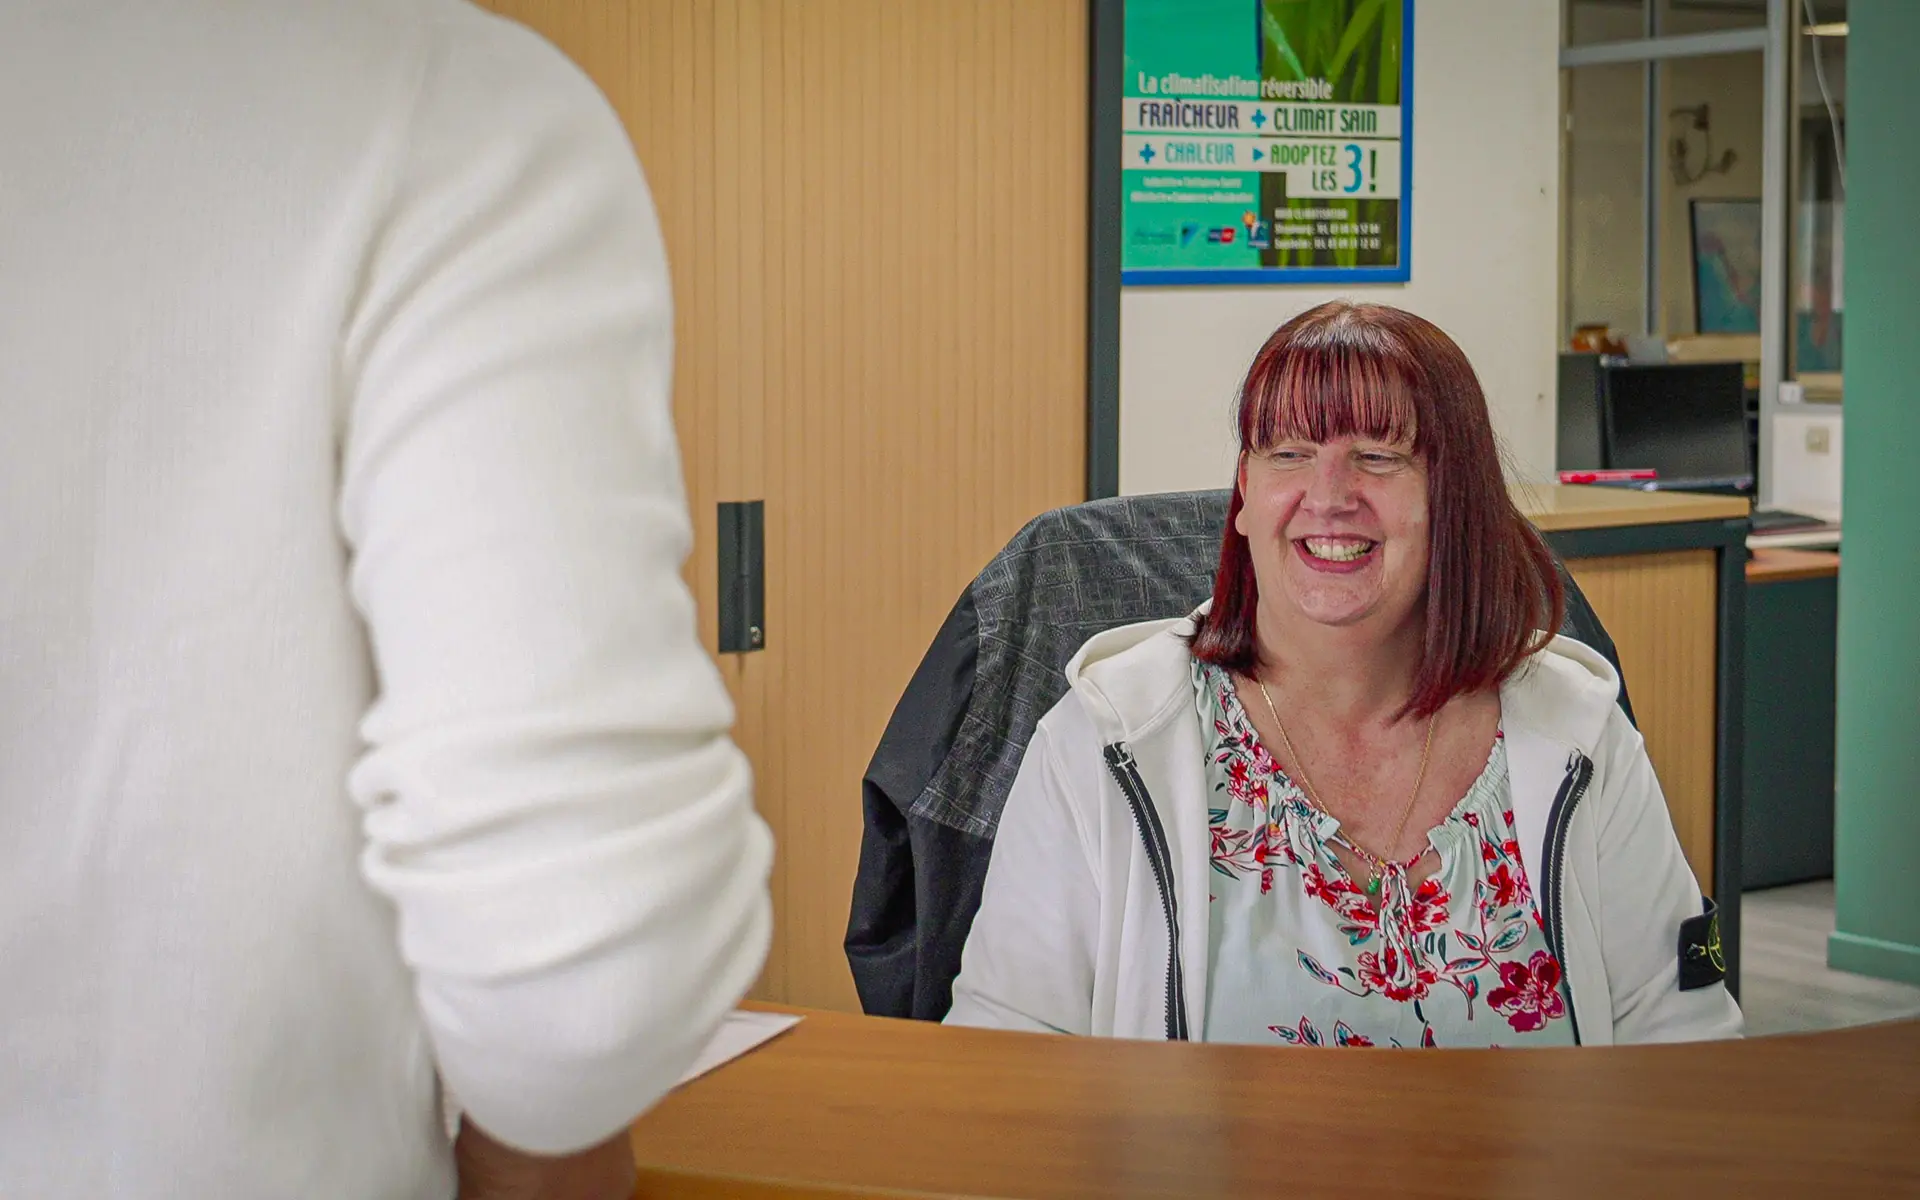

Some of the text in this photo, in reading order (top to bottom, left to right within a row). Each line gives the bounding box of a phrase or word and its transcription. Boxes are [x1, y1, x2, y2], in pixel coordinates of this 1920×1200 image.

[1138, 71, 1334, 100] La climatisation réversible
[1273, 108, 1335, 132] CLIMAT
[1340, 109, 1377, 133] SAIN
[1165, 143, 1235, 164] CHALEUR
[1270, 144, 1337, 166] ADOPTEZ
[1312, 170, 1337, 192] LES
